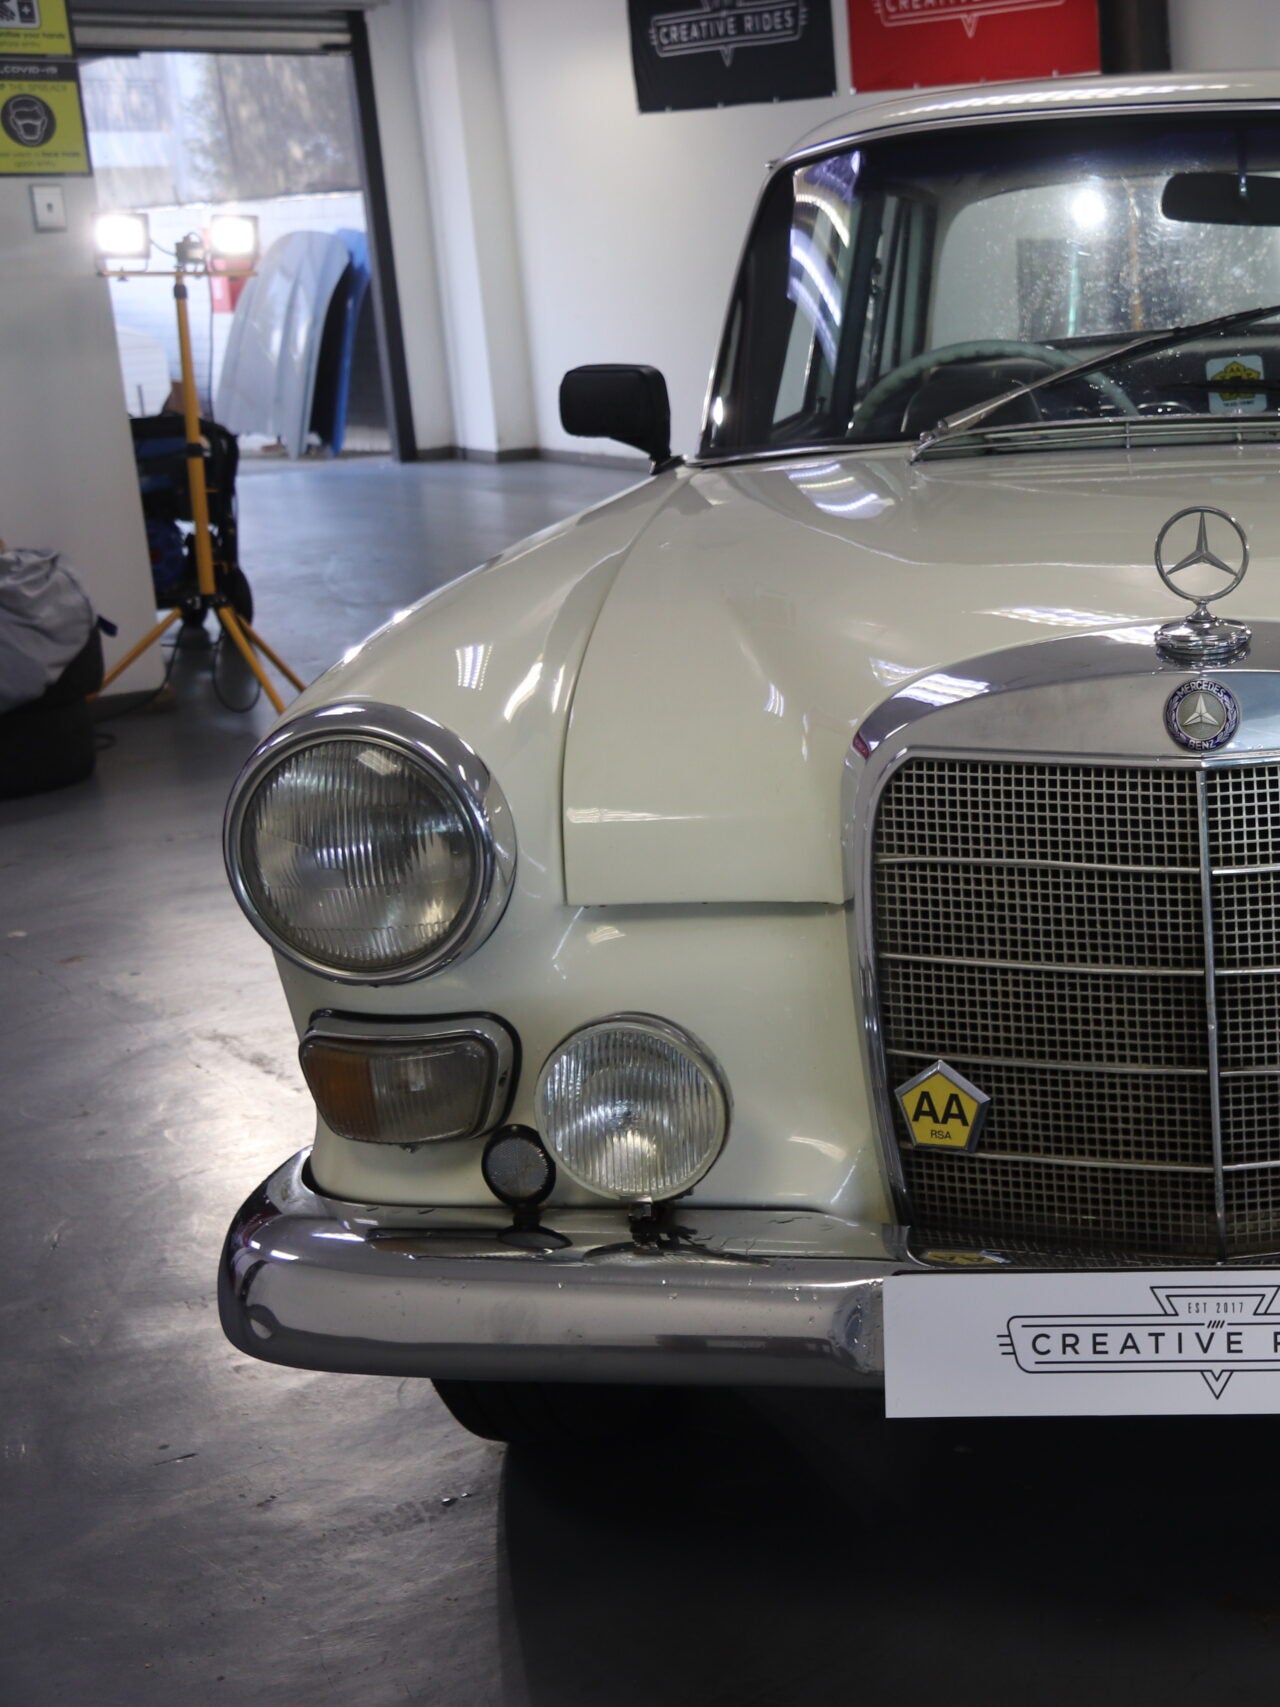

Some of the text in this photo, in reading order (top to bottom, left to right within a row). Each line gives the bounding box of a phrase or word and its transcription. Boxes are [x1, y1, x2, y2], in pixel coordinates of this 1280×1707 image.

[658, 9, 795, 44] CREATIVE RIDES
[1176, 680, 1226, 699] MERCEDES
[1187, 739, 1217, 750] BENZ
[911, 1091, 969, 1127] AA
[930, 1129, 952, 1140] RSA
[1187, 1302, 1244, 1314] EST 2017
[1031, 1331, 1244, 1356] CREATIVE
